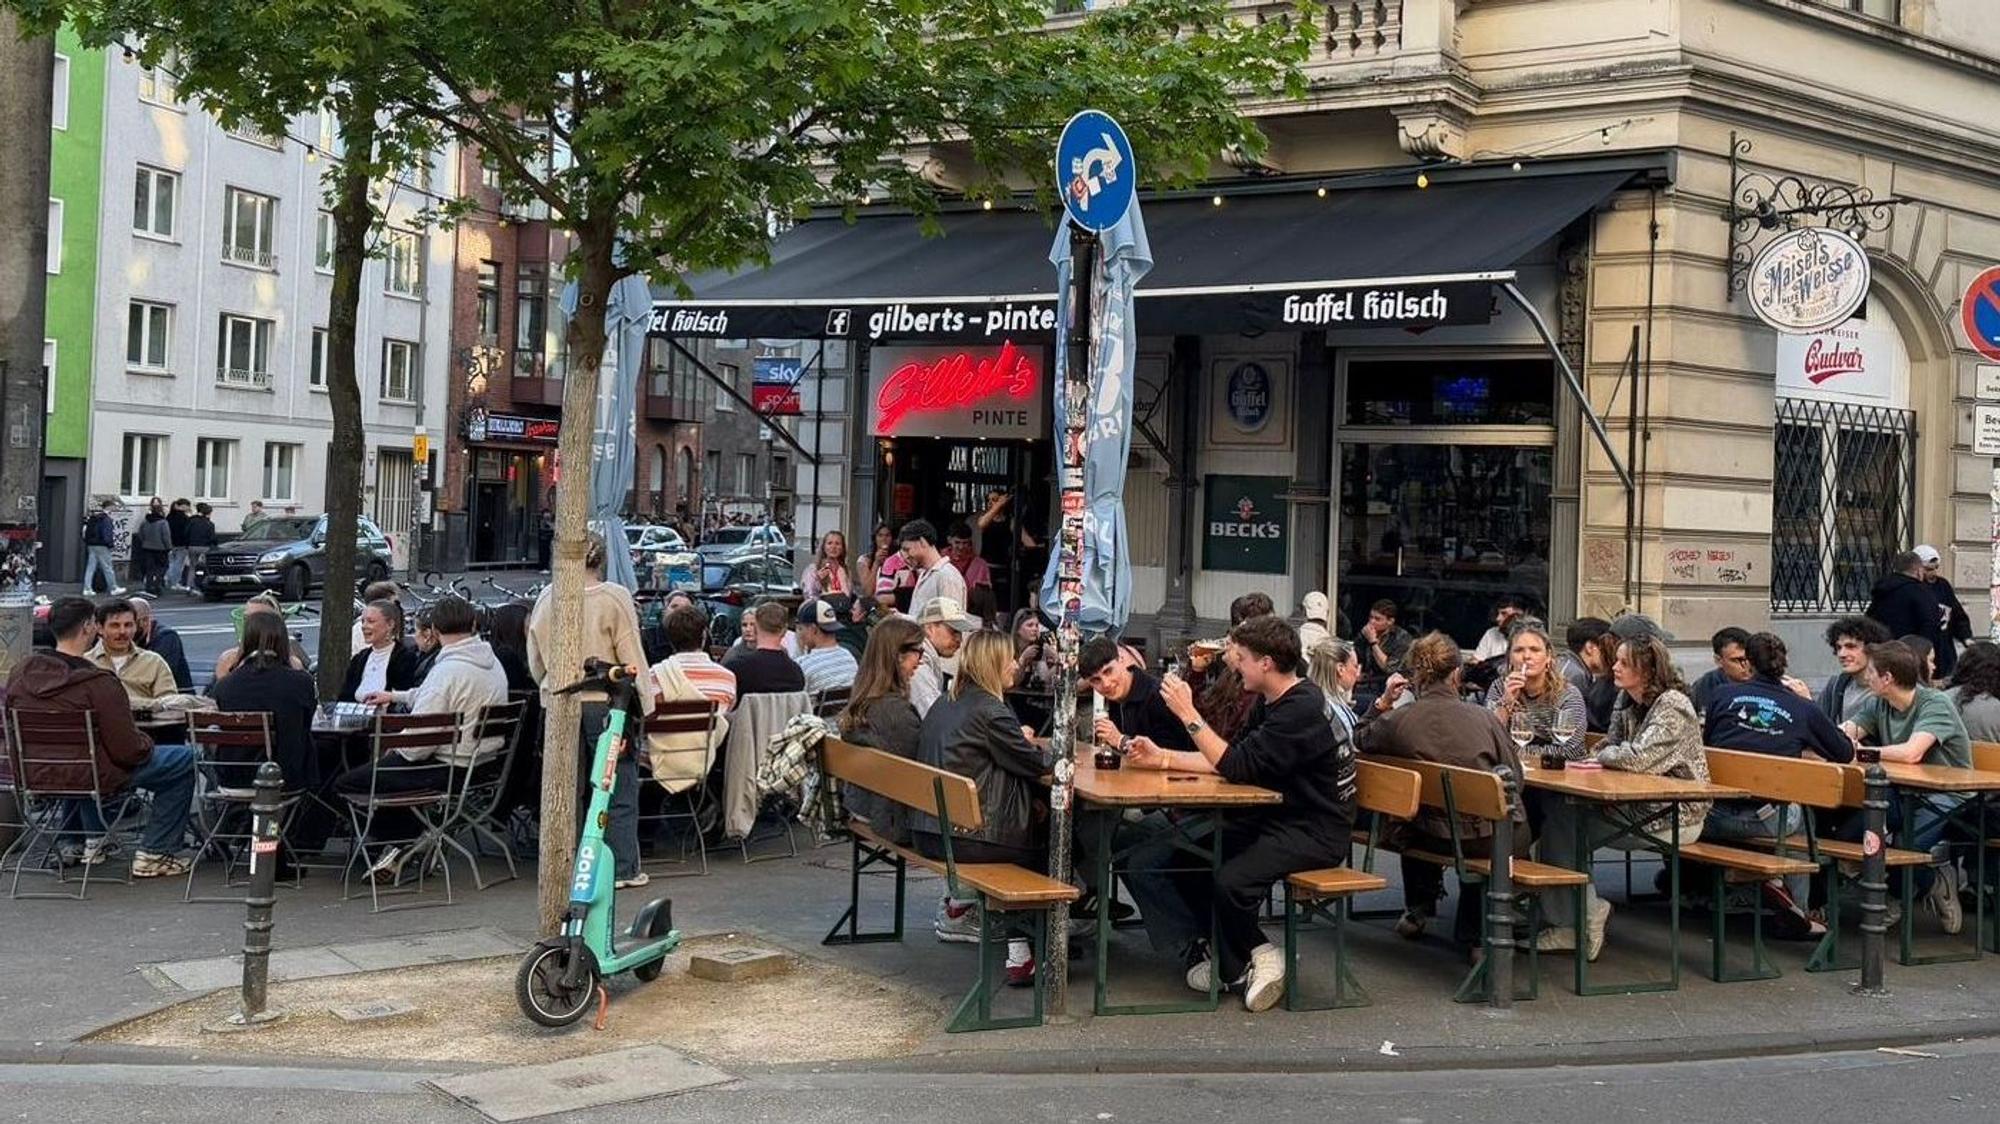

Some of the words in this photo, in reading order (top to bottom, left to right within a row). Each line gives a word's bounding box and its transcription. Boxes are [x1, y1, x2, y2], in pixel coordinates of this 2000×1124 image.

[1792, 252, 1853, 304] Weisse
[671, 309, 729, 335] Kölsch
[1283, 292, 1354, 325] Gaffel
[1363, 289, 1448, 320] Kölsch
[1805, 339, 1864, 374] Budvar
[769, 363, 800, 385] sky
[973, 410, 1028, 425] PINTE
[1210, 521, 1280, 538] BECK'S
[574, 845, 595, 892] dott
